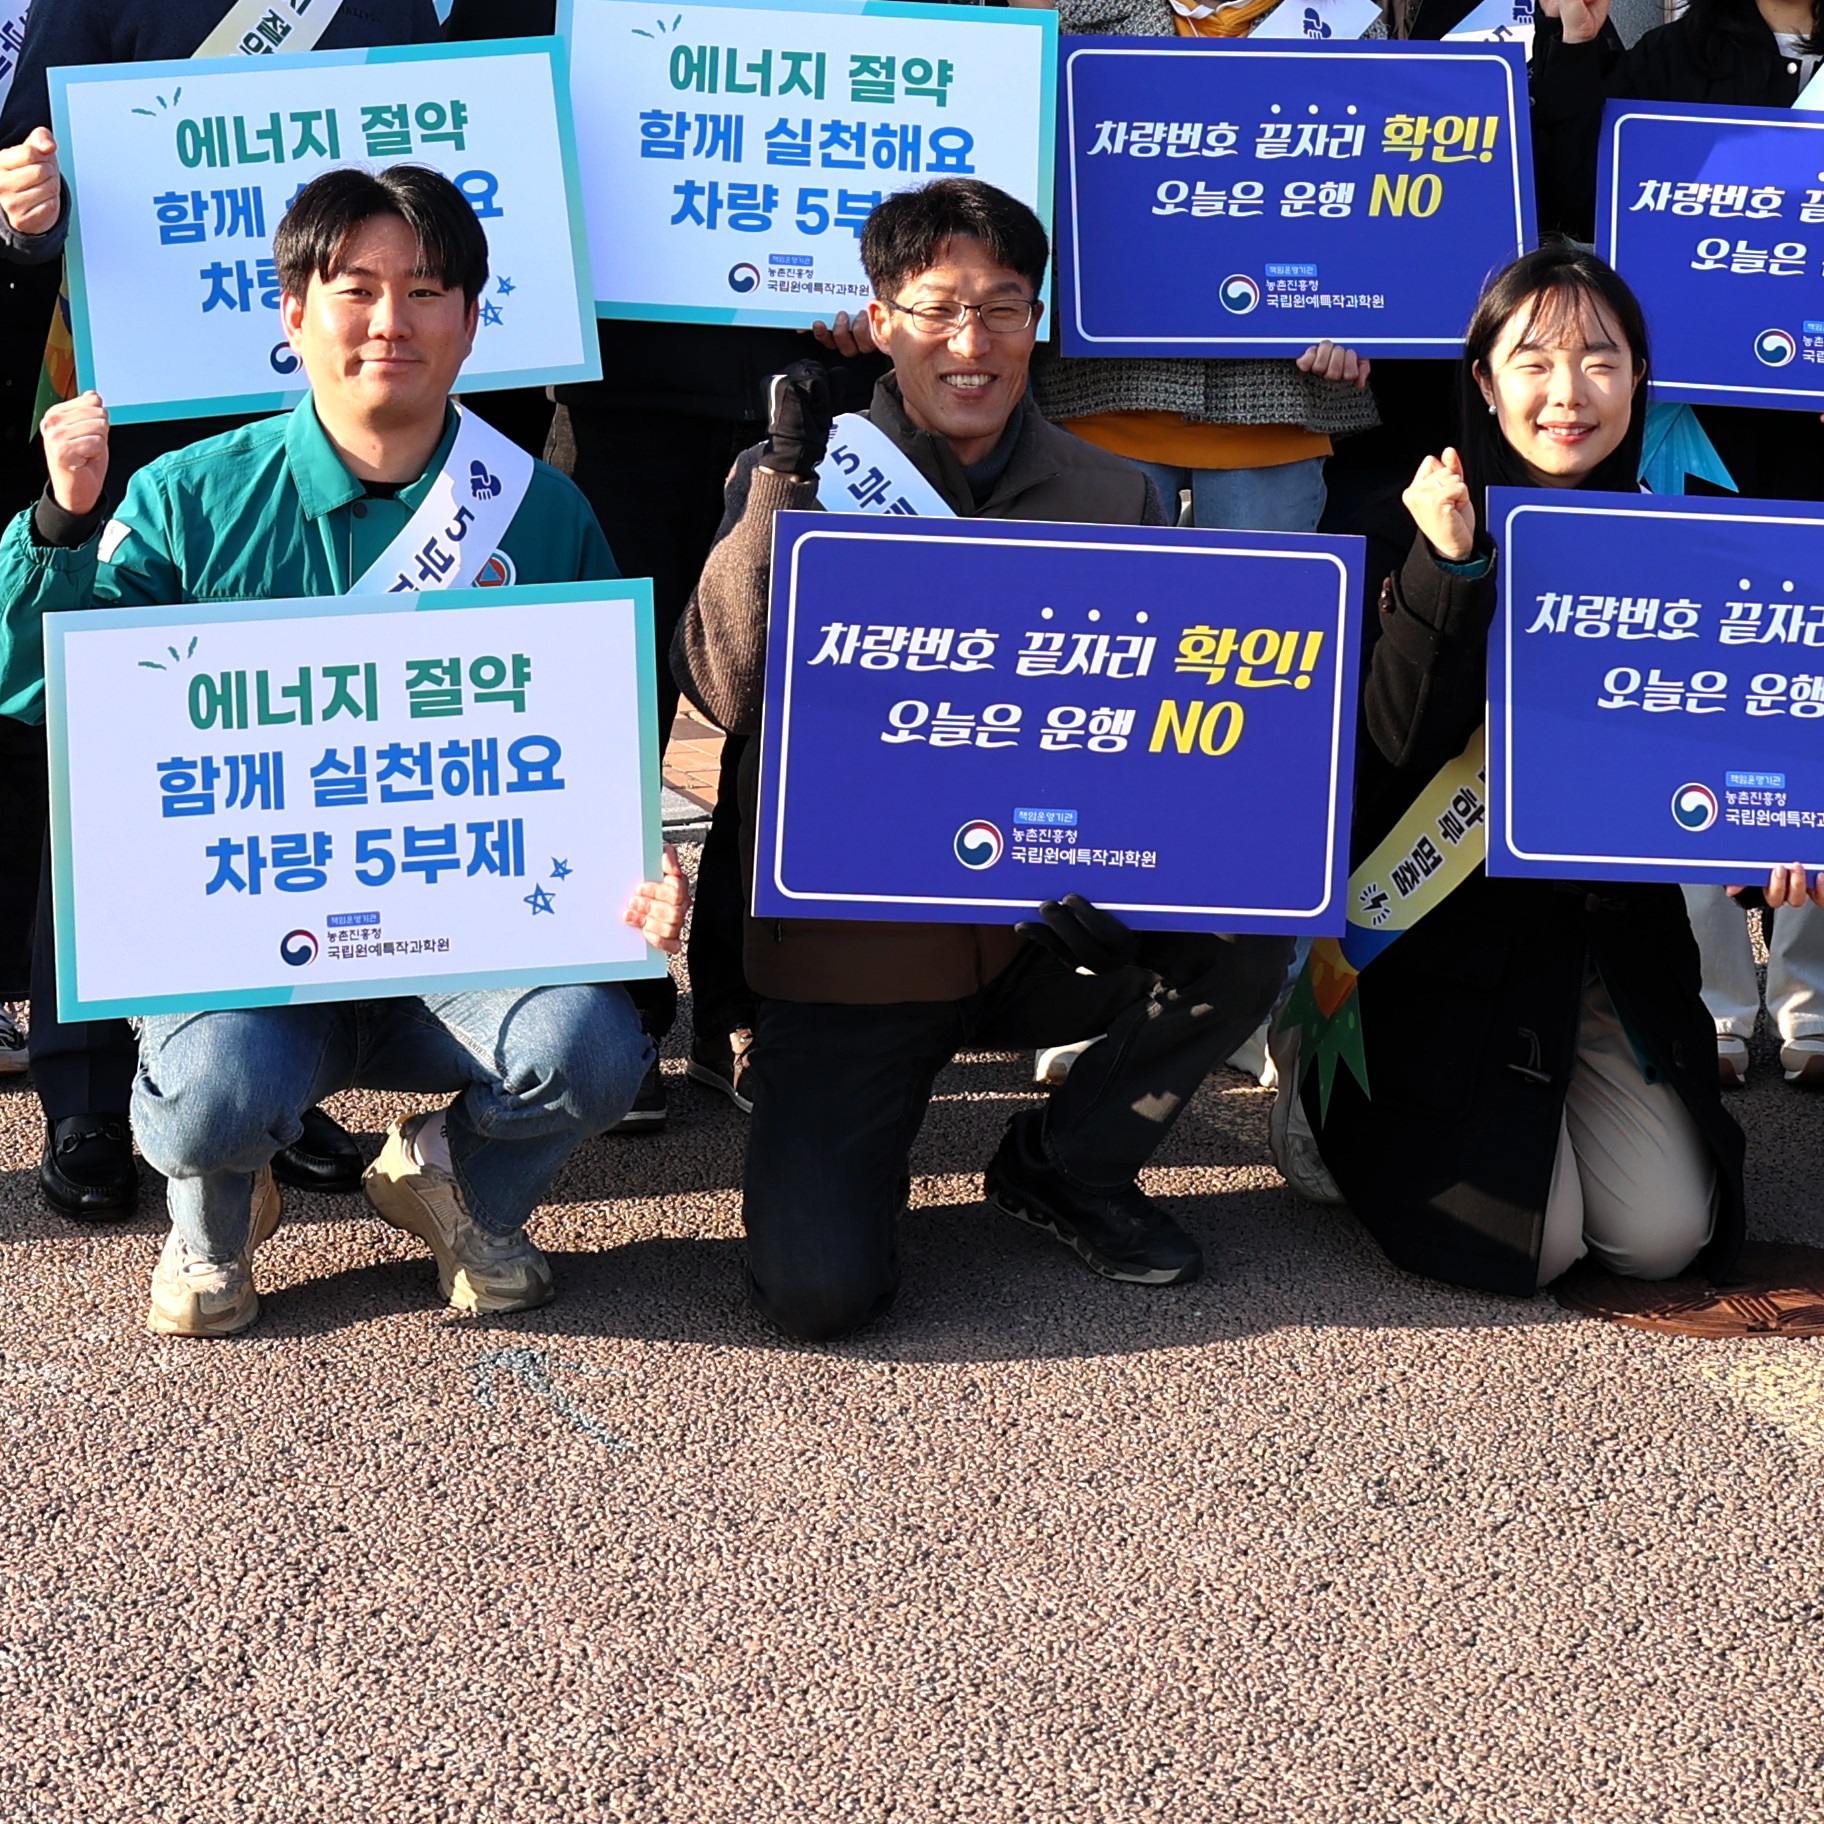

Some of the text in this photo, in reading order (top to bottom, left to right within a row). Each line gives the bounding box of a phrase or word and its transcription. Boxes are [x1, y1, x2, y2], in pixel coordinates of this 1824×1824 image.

[669, 44, 954, 108] 에너지 절약
[176, 99, 469, 169] 에너지 절약
[639, 109, 976, 175] 함께 실천해요
[1086, 114, 1499, 163] 차량번호 끝자리 확인!
[153, 186, 266, 246] 함께
[670, 179, 883, 240] 차량 5부
[1151, 173, 1443, 218] 오늘은 운행 NO
[1629, 179, 1786, 219] 차량번호
[767, 267, 814, 280] 농촌진흥청
[1690, 238, 1807, 276] 오늘은
[767, 279, 870, 297] 국립원예특작과학원
[1266, 279, 1319, 292] 농촌진흥청
[1266, 294, 1385, 309] 국립원예특작과학원
[1525, 592, 1702, 641] 차량번호
[807, 622, 1324, 690] 차량번호 끝자리 확인!
[188, 653, 532, 730] 에너지 절약
[1597, 667, 1728, 714] 오늘은
[880, 699, 1244, 756] 오늘은 운행 NO
[156, 734, 565, 818] 함께 실천해요
[1725, 790, 1787, 807] 농촌진흥청
[1012, 827, 1078, 844] 농촌진흥청
[1018, 810, 1073, 823] 책임운영기관
[205, 817, 525, 896] 차량 5부제
[1011, 846, 1157, 868] 국립원예특작과학원
[1390, 787, 1486, 898] 하루 멈춤
[327, 928, 382, 943] 농촌진흥청
[327, 937, 450, 960] 국립원예특작과학원
